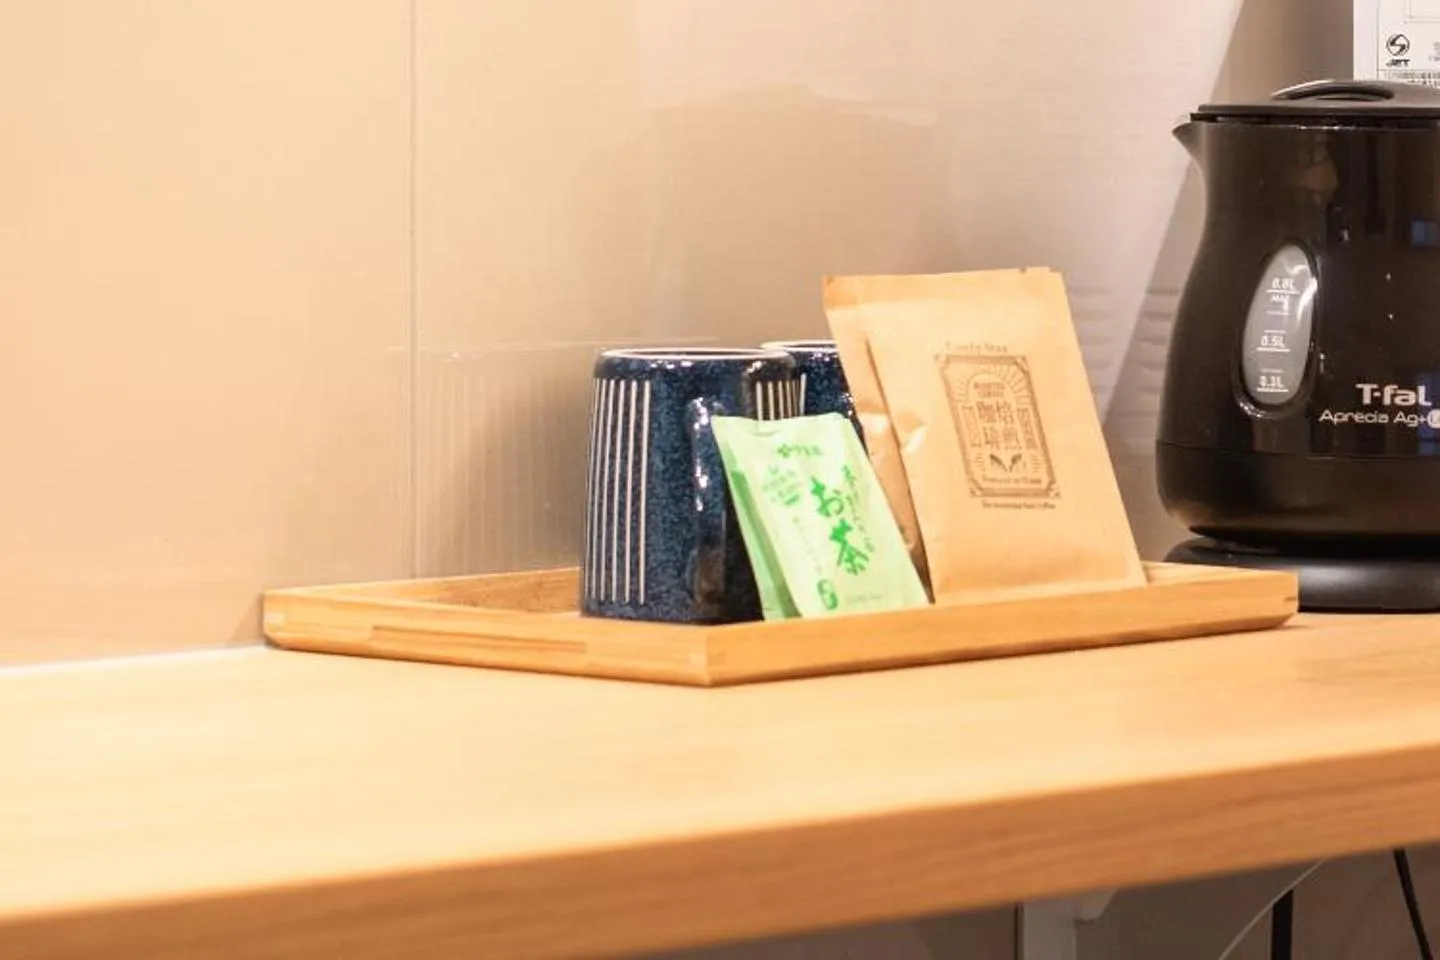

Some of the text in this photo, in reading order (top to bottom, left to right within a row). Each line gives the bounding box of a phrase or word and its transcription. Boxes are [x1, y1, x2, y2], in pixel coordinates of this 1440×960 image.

[1355, 383, 1432, 406] T-fal
[1318, 409, 1389, 425] Aprecia
[810, 476, 870, 576] お茶
